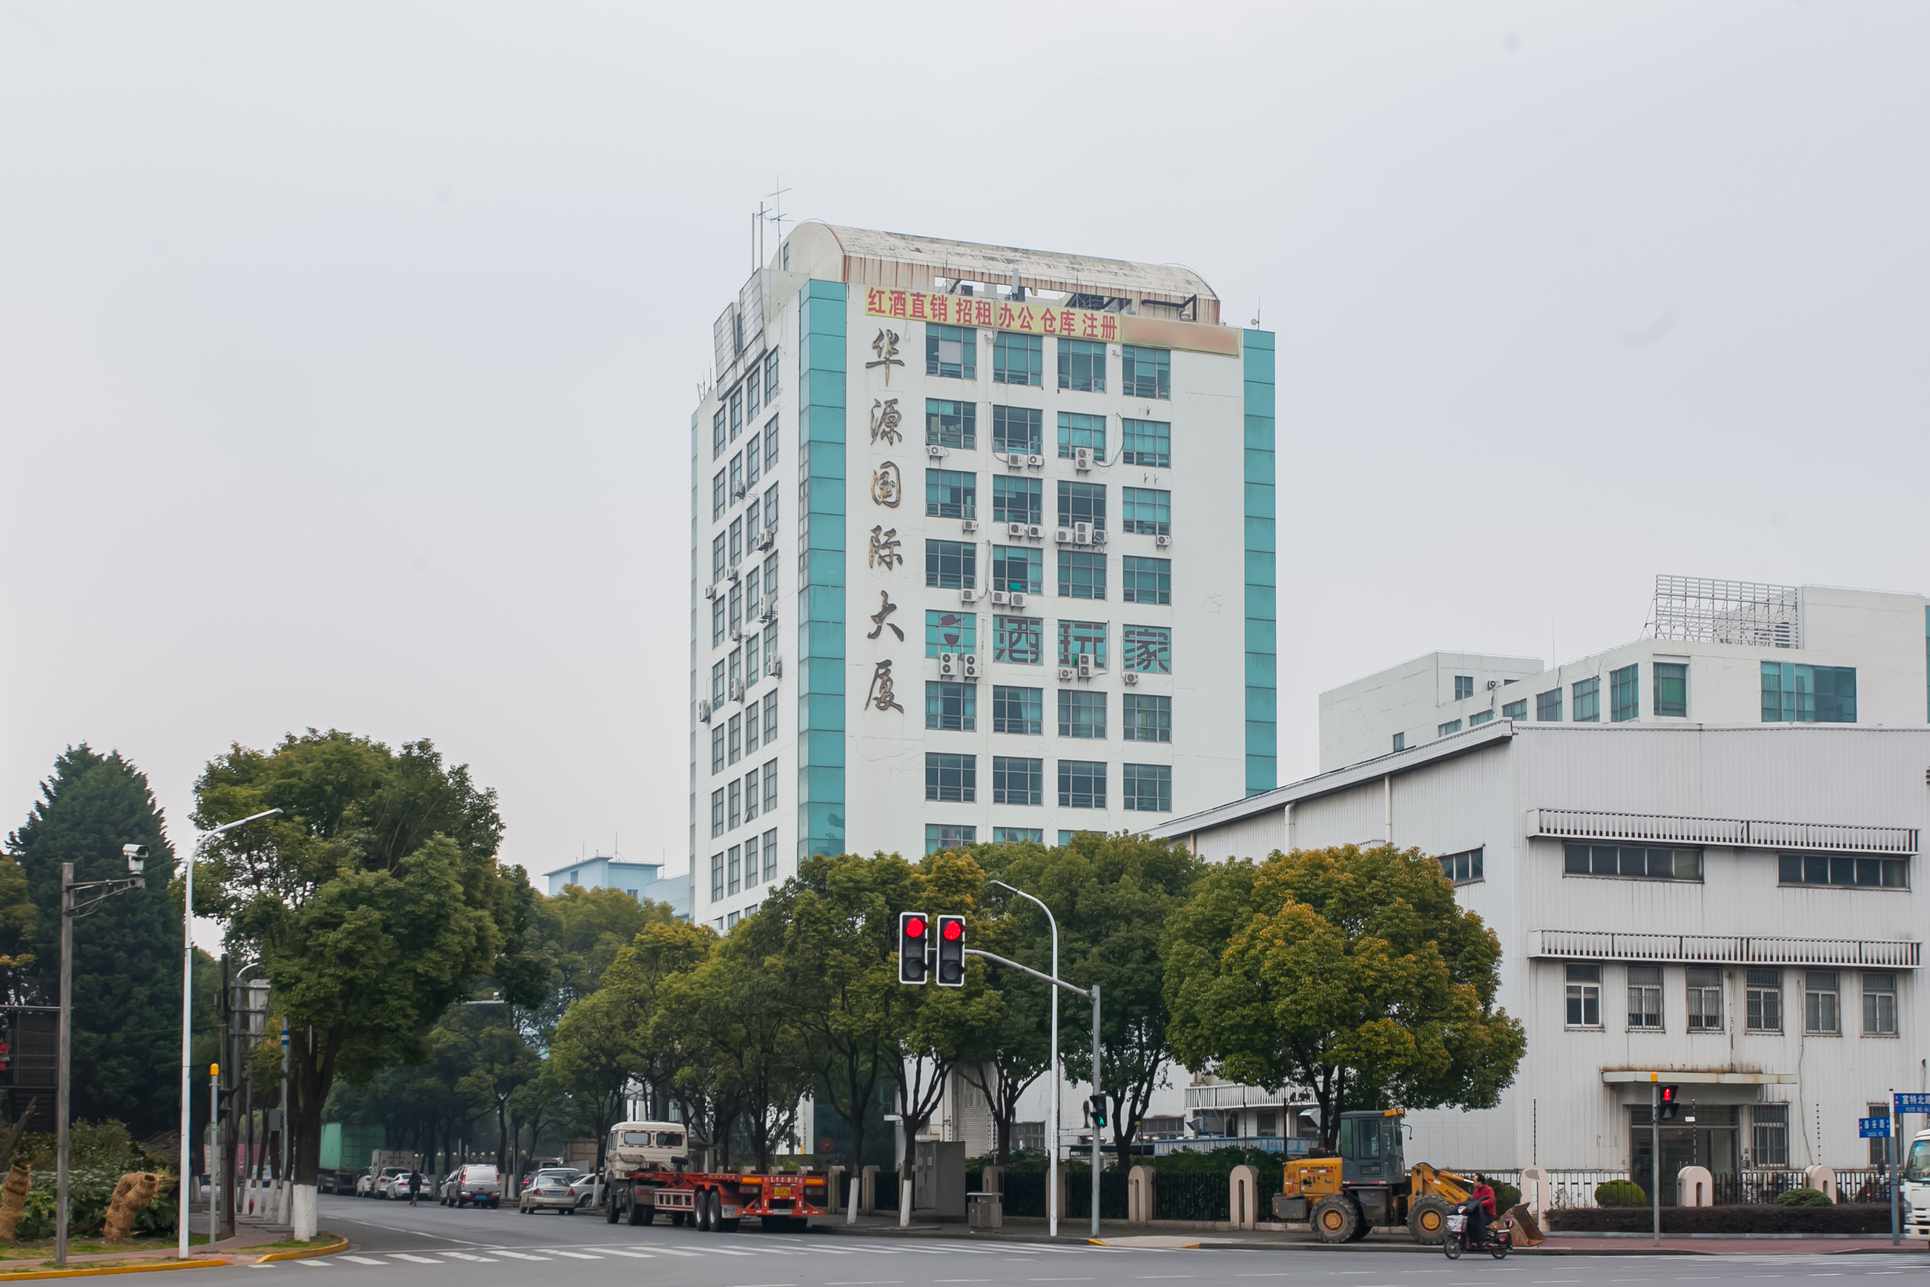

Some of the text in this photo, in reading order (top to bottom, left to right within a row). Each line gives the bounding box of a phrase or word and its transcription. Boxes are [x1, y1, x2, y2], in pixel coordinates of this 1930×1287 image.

[865, 329, 905, 714] 华源国际大厦
